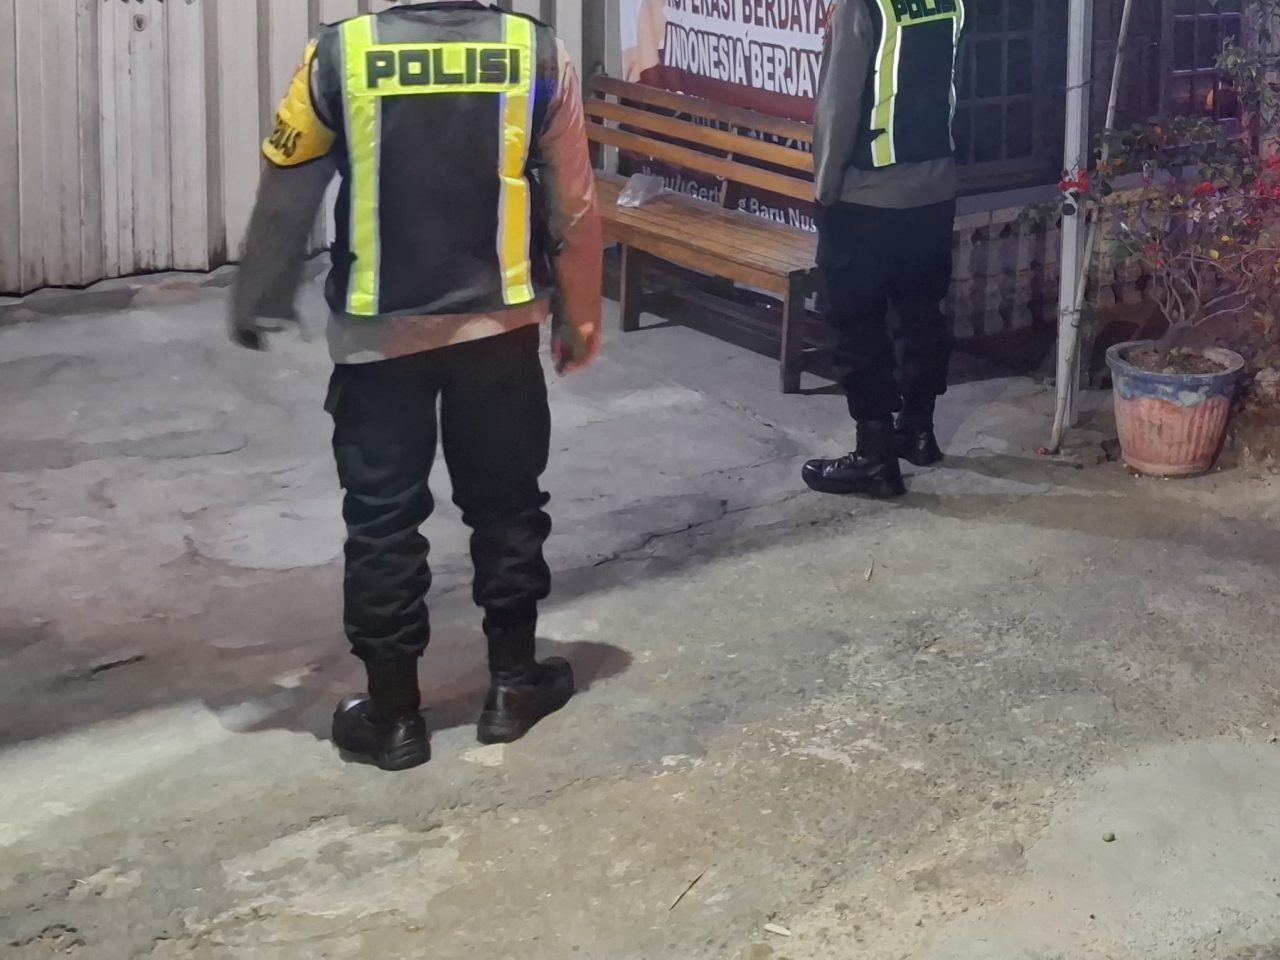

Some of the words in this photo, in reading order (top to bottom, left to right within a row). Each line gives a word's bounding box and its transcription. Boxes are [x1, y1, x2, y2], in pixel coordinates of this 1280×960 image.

[364, 47, 521, 89] POLISI
[664, 22, 748, 86] INDONESIA
[750, 40, 823, 99] BERJAY
